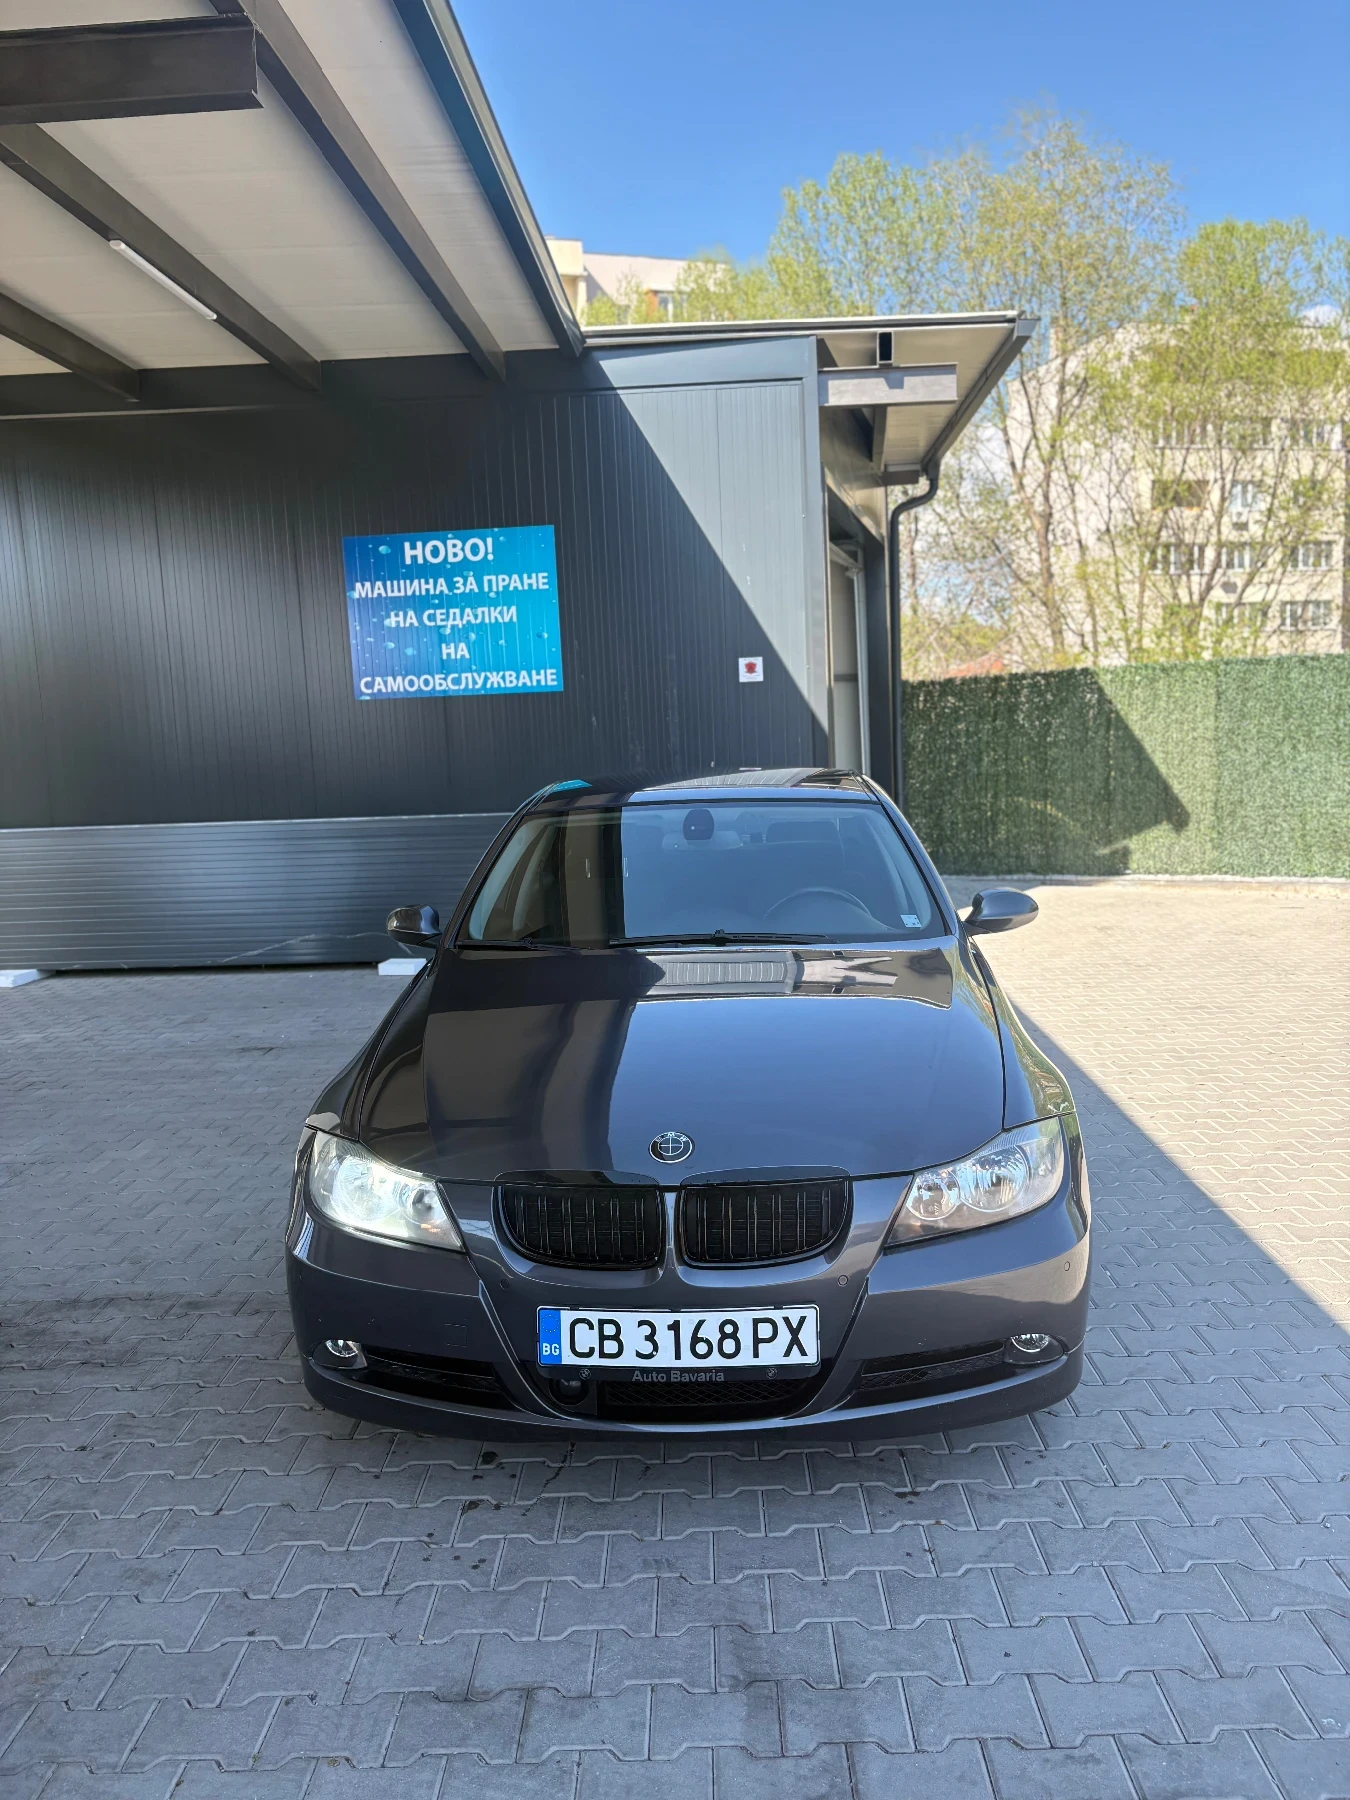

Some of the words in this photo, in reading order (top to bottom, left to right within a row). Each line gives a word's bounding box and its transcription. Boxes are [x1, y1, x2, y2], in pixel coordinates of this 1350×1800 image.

[404, 537, 494, 565] НОВО!
[354, 577, 449, 599] МАШИНА
[453, 575, 479, 594] ЗА
[483, 572, 549, 592] ПРАНЕ
[390, 610, 418, 628] НА
[422, 605, 517, 628] СЕДАЛКИ
[441, 642, 470, 660] НА
[360, 669, 558, 694] САМООБСЛУЖВАНЕ
[542, 1343, 560, 1356] BG
[569, 1317, 625, 1359] CB
[635, 1318, 742, 1360] 3168
[752, 1315, 808, 1359] PX
[632, 1370, 667, 1382] Auto
[670, 1369, 725, 1382] Bavaria
